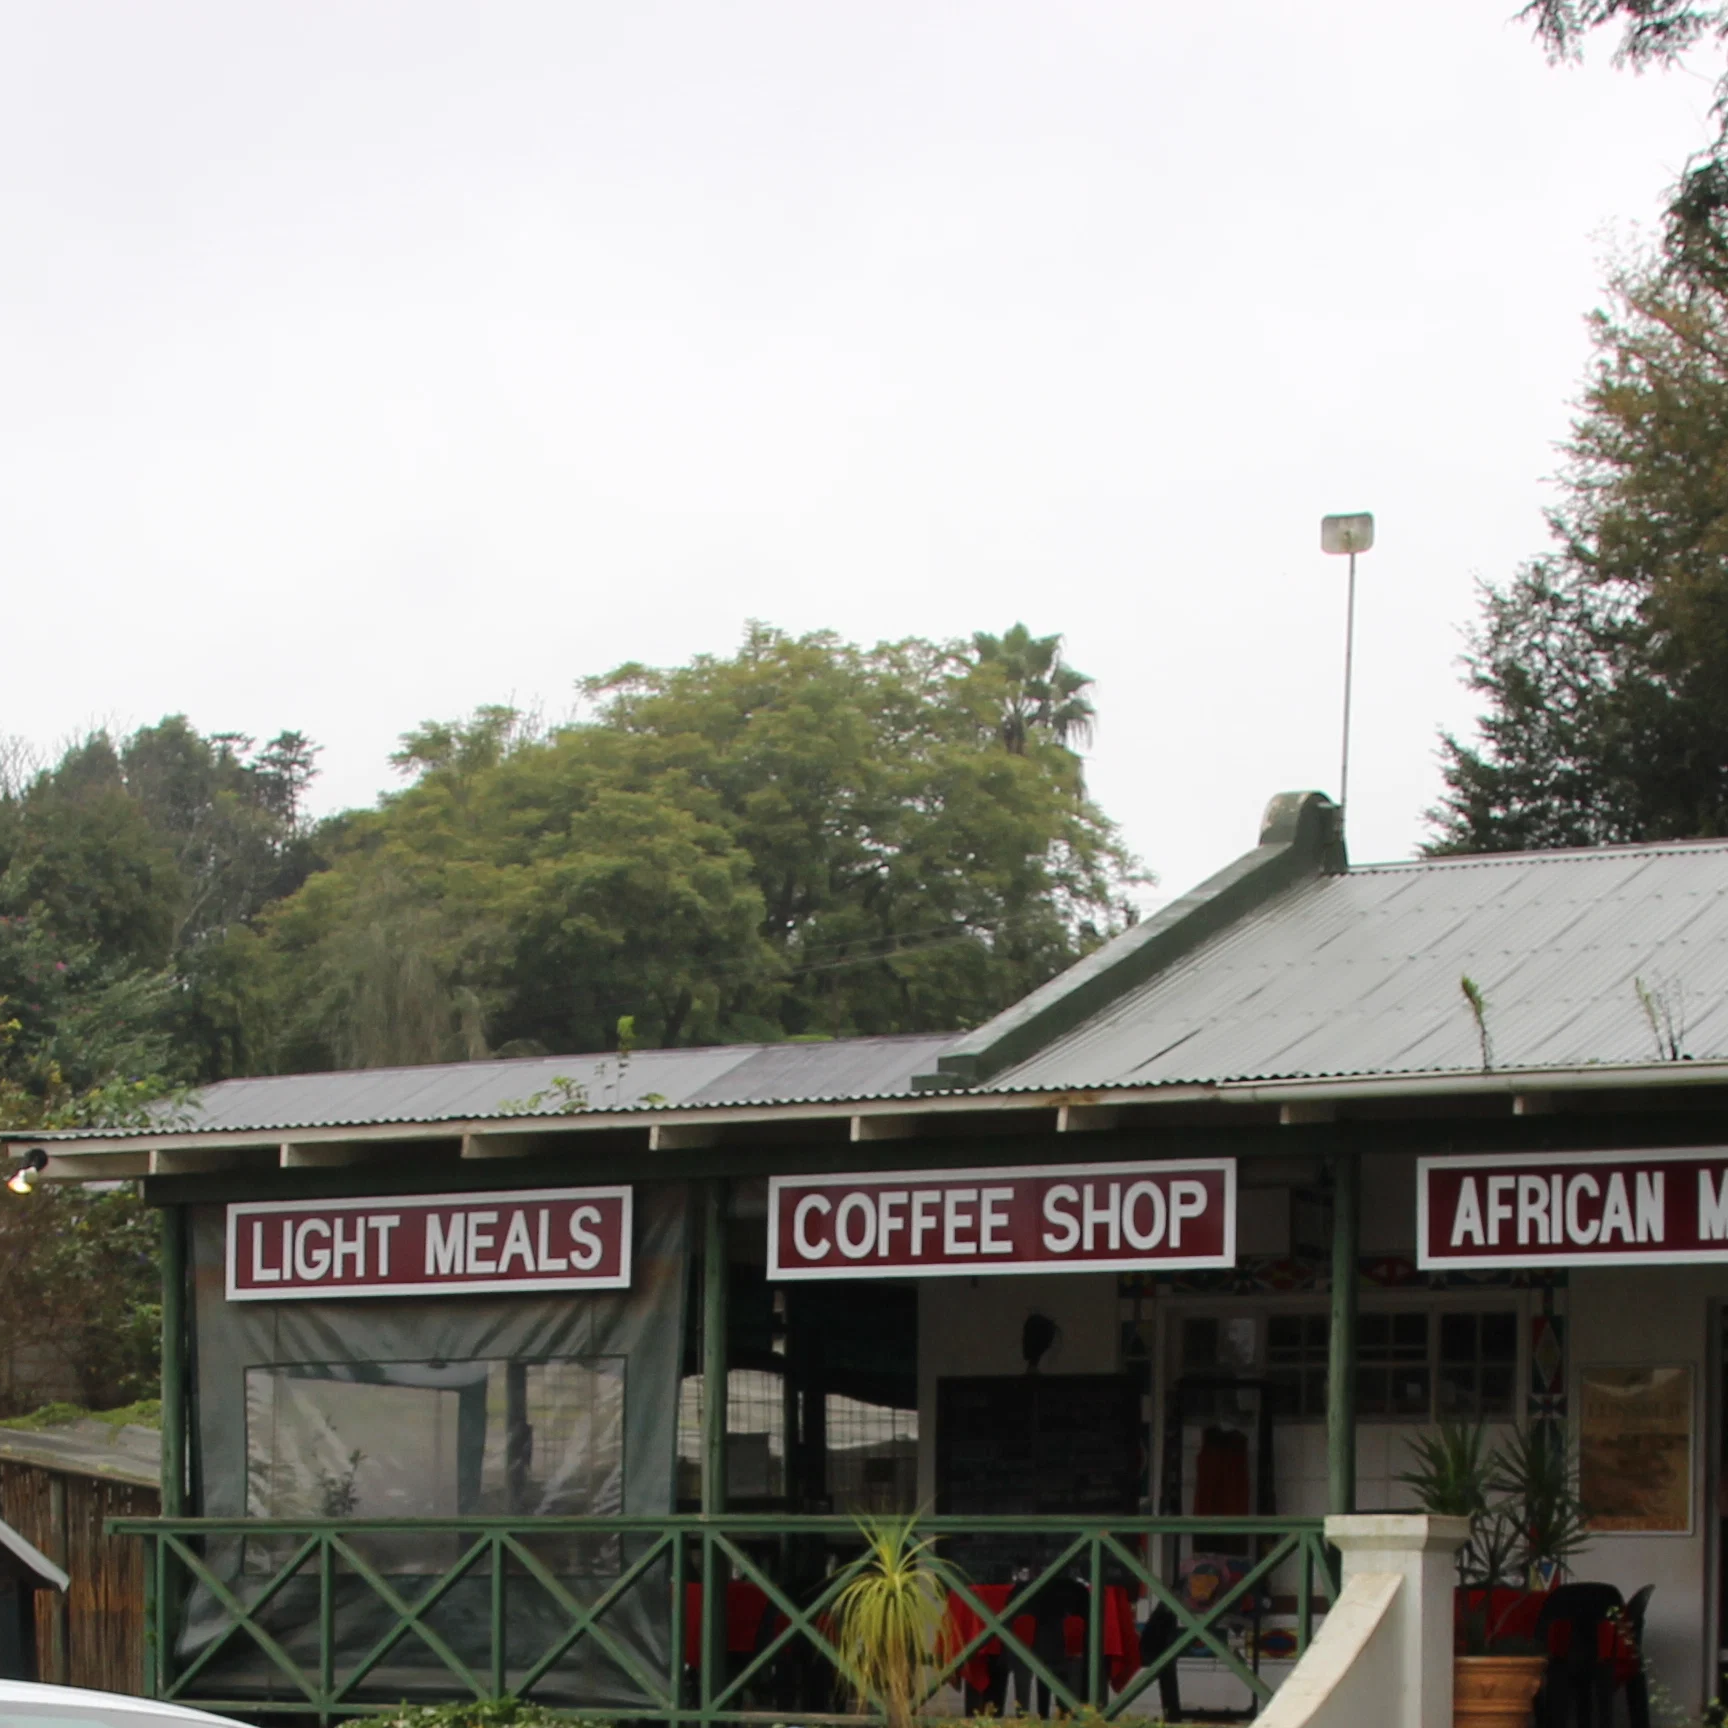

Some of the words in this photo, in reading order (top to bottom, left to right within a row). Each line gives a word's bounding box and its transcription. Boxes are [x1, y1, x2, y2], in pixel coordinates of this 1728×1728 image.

[252, 1214, 400, 1282] LIGHT
[425, 1205, 603, 1276] MEALS
[793, 1187, 1015, 1261] COFFEE
[1042, 1180, 1209, 1253] SHOP
[1450, 1171, 1665, 1247] AFRICAN
